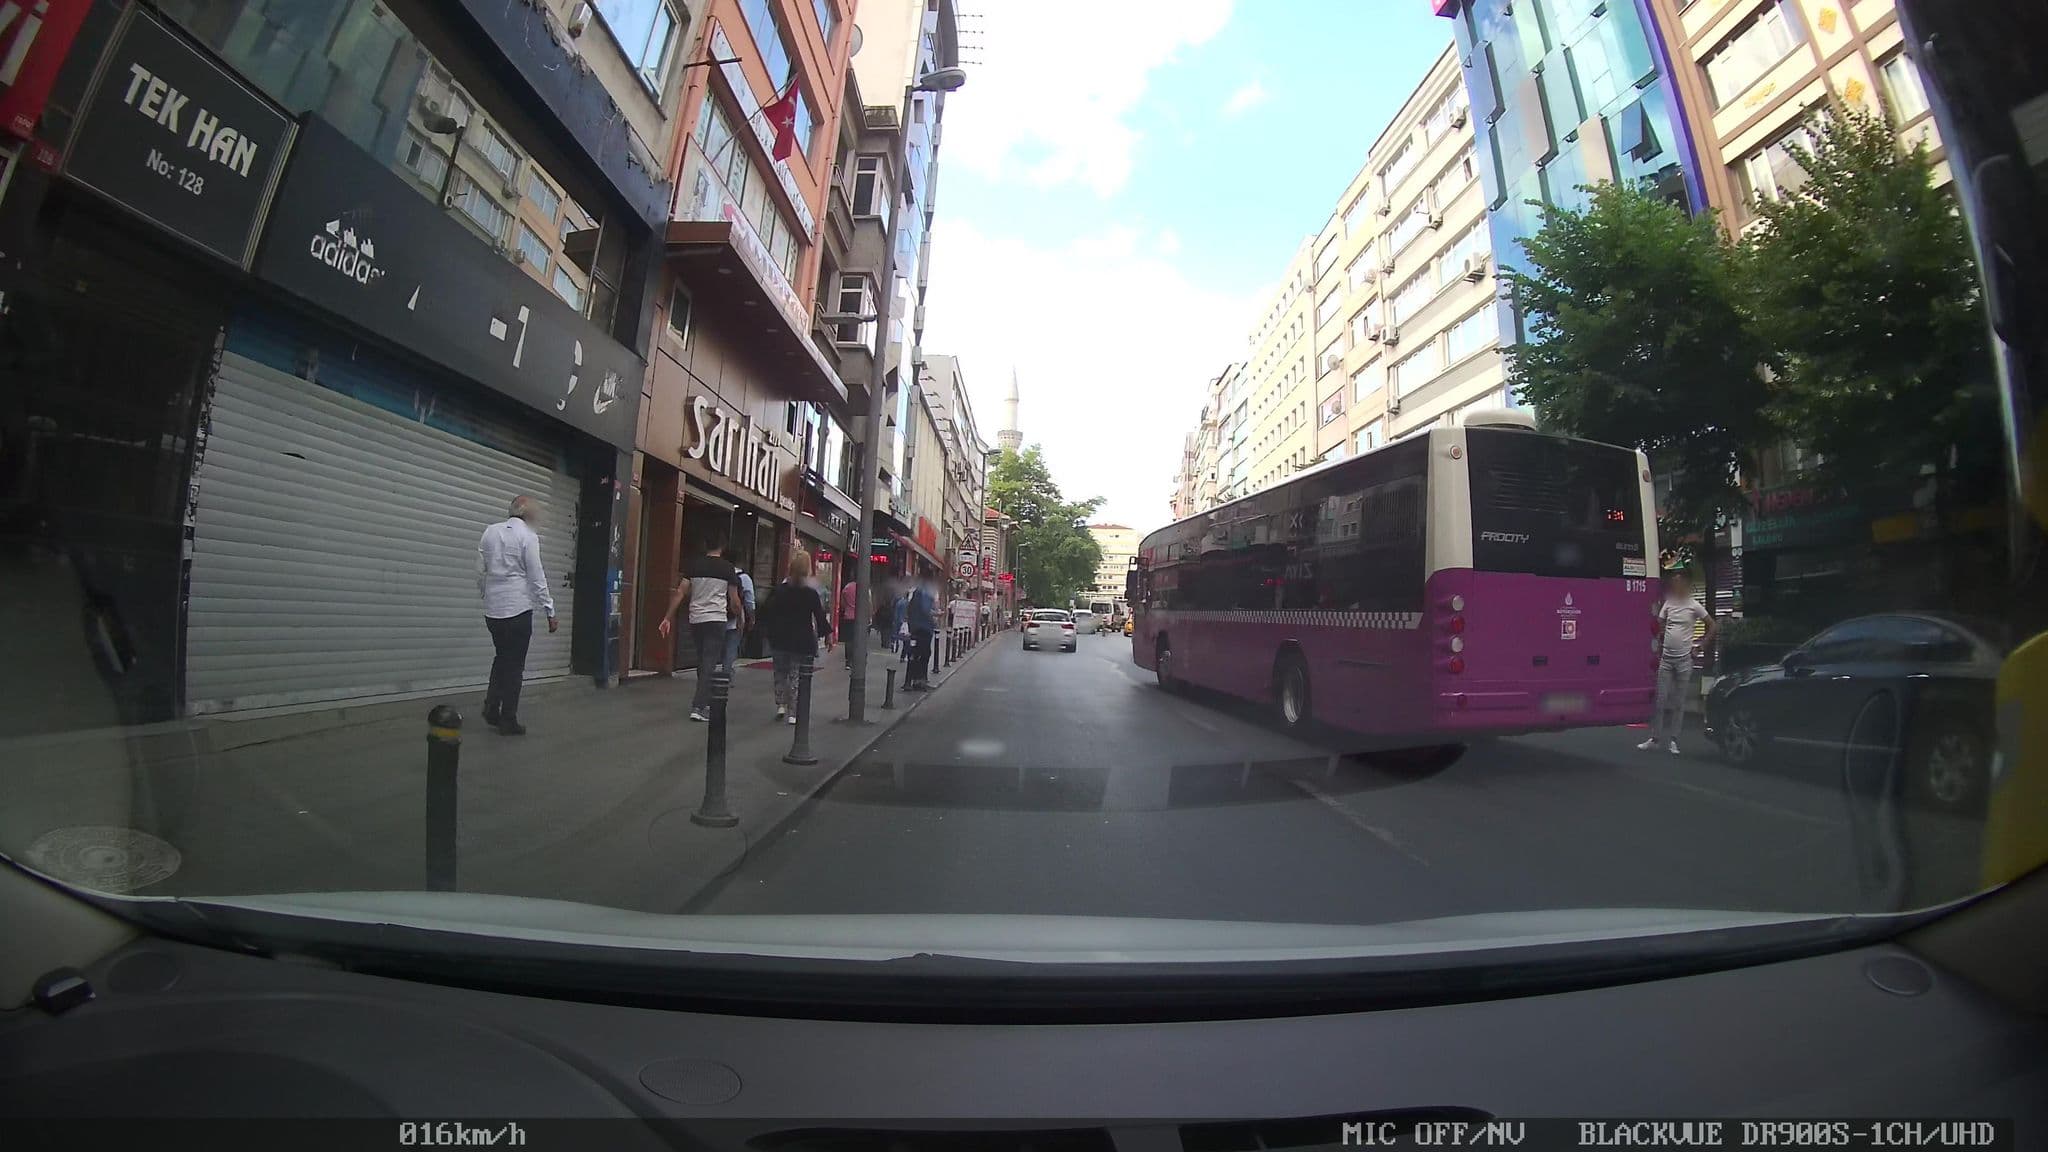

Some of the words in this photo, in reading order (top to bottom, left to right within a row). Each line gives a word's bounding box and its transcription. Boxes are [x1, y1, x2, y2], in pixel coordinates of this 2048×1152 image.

[124, 62, 190, 135] TEK
[187, 108, 258, 178] HAN
[146, 149, 175, 180] No:
[178, 167, 205, 196] 128
[1480, 531, 1530, 544] PROCITY
[962, 566, 972, 575] 30
[1626, 580, 1632, 592] B
[1632, 580, 1647, 593] 1715
